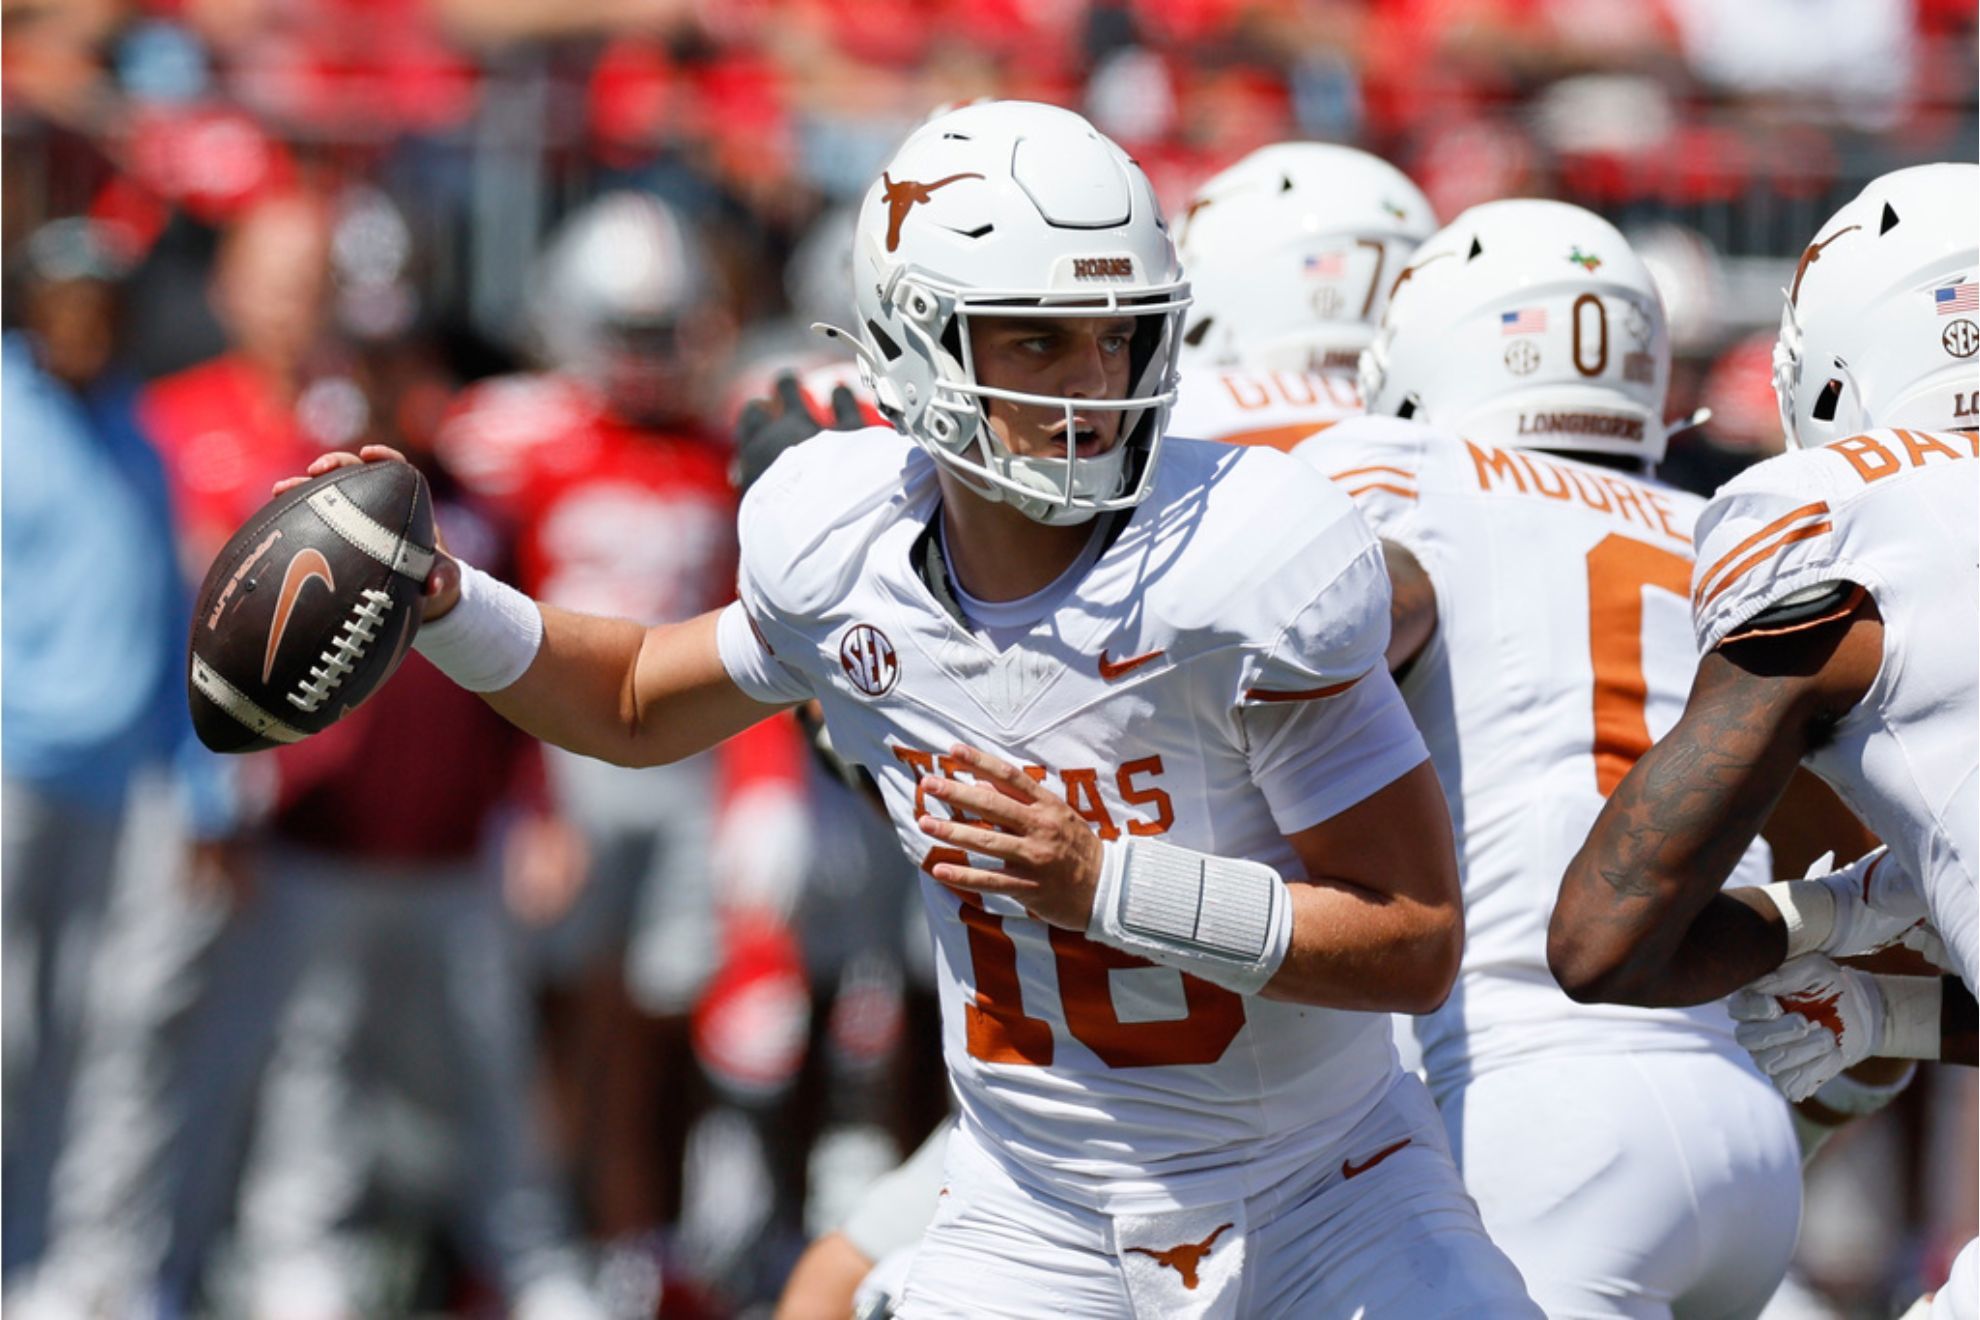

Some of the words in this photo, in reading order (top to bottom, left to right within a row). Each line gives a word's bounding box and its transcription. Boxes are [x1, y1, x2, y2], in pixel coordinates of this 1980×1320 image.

[1073, 258, 1133, 278] HORNS
[1355, 239, 1386, 320] 7
[1572, 292, 1608, 378] 0
[1942, 319, 1979, 358] SEC
[1518, 412, 1645, 443] LONGHORNS
[1464, 438, 1693, 545] MOORE
[841, 624, 897, 696] SEC
[891, 744, 1175, 841] TEAS
